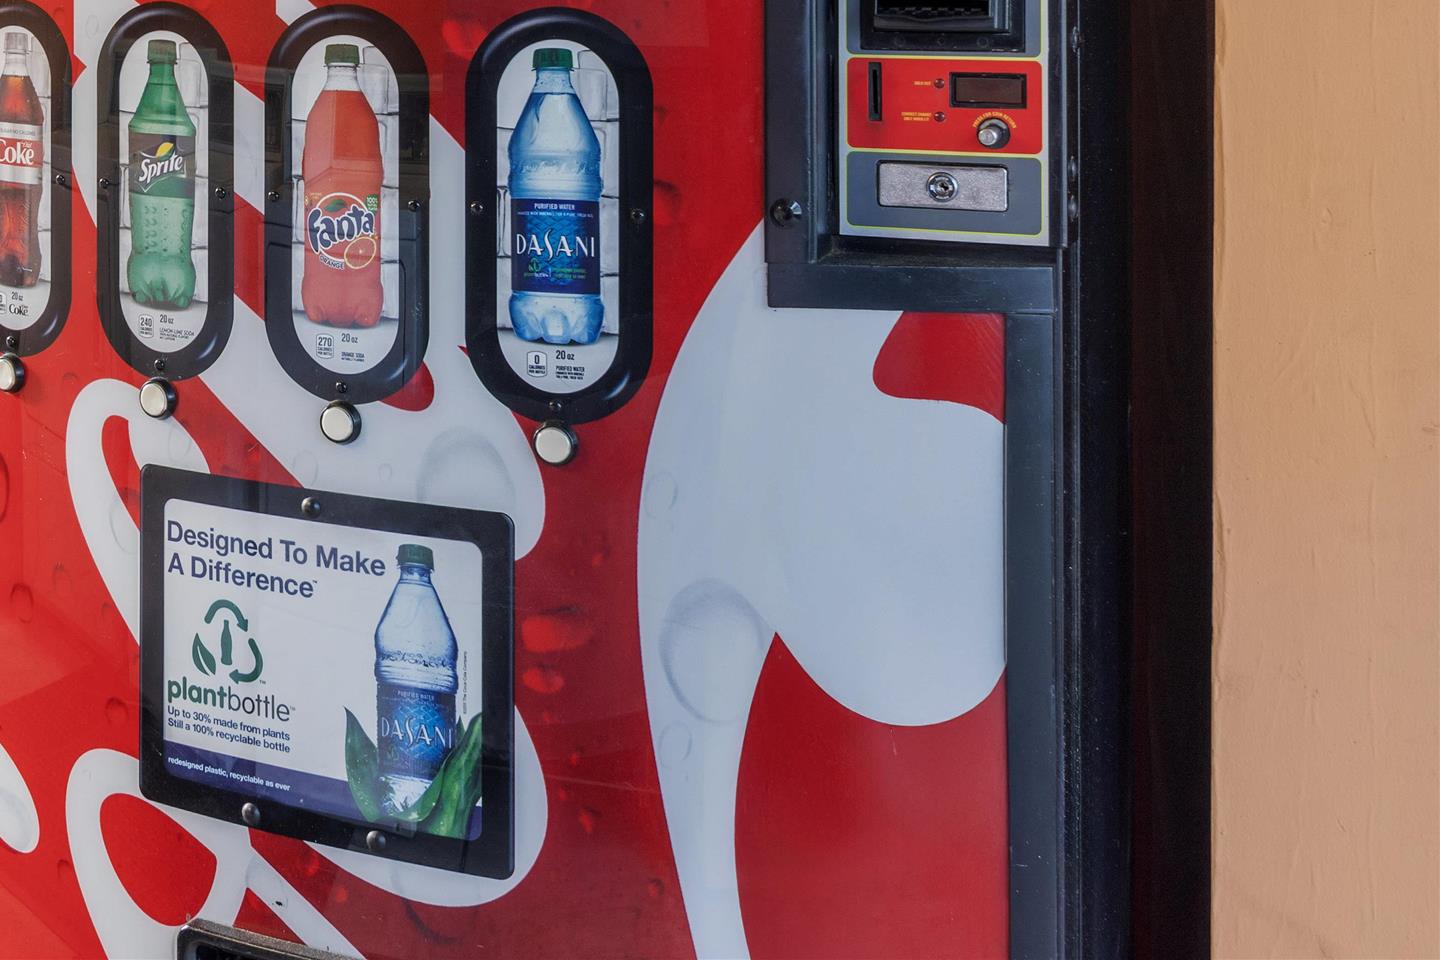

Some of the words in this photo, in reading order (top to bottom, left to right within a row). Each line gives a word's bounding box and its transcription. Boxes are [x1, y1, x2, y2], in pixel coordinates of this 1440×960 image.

[138, 150, 183, 184] Sprite
[516, 228, 595, 261] DASANI
[320, 254, 345, 270] ORANGE
[160, 314, 167, 323] 20
[318, 336, 332, 347] 270
[341, 333, 350, 343] 20
[556, 350, 566, 360] 20
[167, 519, 273, 560] Designed
[279, 539, 308, 565] To
[316, 545, 386, 577] Make
[167, 552, 184, 576] A
[191, 555, 314, 598] Difference
[167, 676, 290, 722] plantbottle
[167, 705, 180, 717] Up
[182, 709, 191, 719] to
[193, 711, 212, 724] 30%
[213, 718, 238, 730] made
[240, 721, 261, 735] from
[262, 727, 290, 741] plants
[167, 718, 184, 729] Still
[185, 723, 191, 731] a
[192, 723, 214, 737] 100%
[215, 729, 261, 746] recyclable
[263, 738, 291, 753] bottle
[381, 716, 452, 749] DASANI
[168, 756, 204, 772] redesigned
[204, 765, 229, 779] plastic,
[229, 771, 264, 786] recyclable
[265, 779, 274, 787] as
[275, 782, 291, 791] ever
